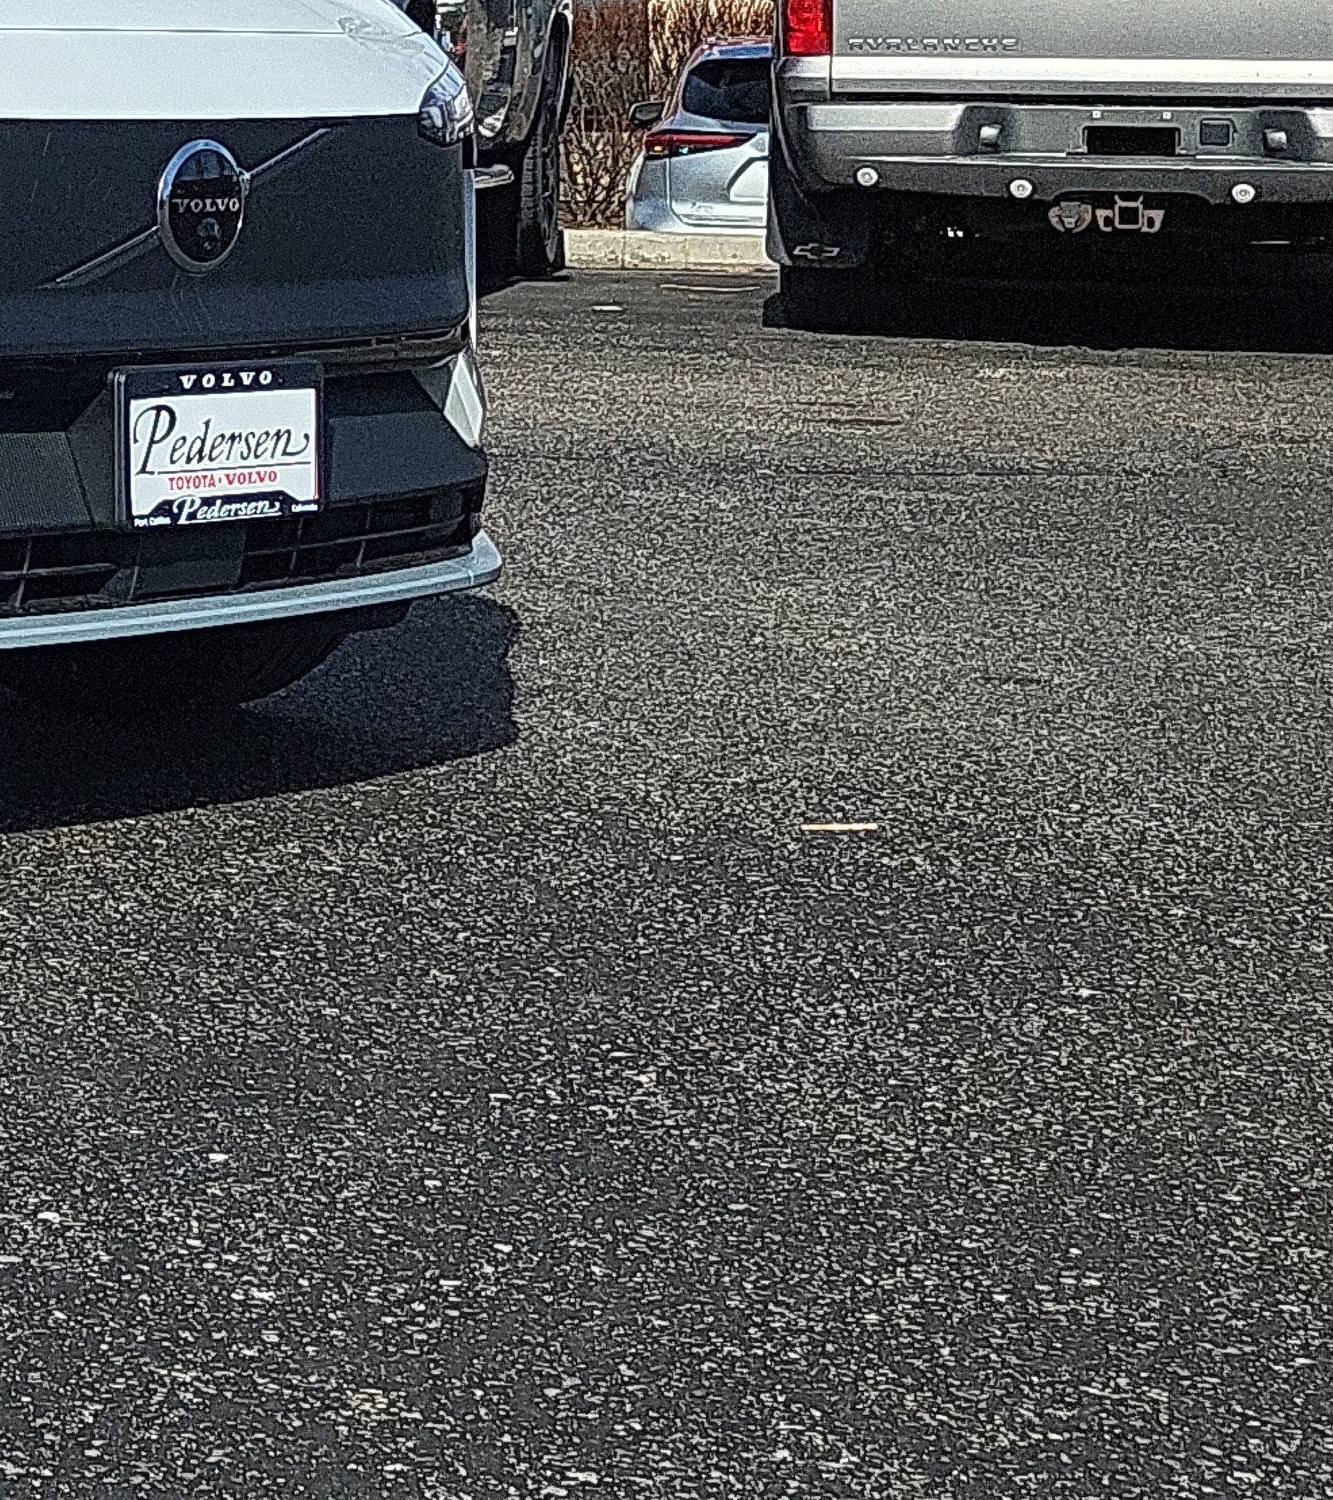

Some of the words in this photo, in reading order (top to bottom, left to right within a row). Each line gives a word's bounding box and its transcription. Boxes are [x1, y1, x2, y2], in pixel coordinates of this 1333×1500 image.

[848, 36, 1019, 52] AVALANCHE
[172, 198, 240, 213] VOLVO
[179, 371, 273, 389] VOLVO
[133, 404, 310, 476] Pedersen
[168, 474, 217, 491] TOYOTA
[224, 470, 278, 486] VOLVO
[173, 495, 281, 525] Pedersen
